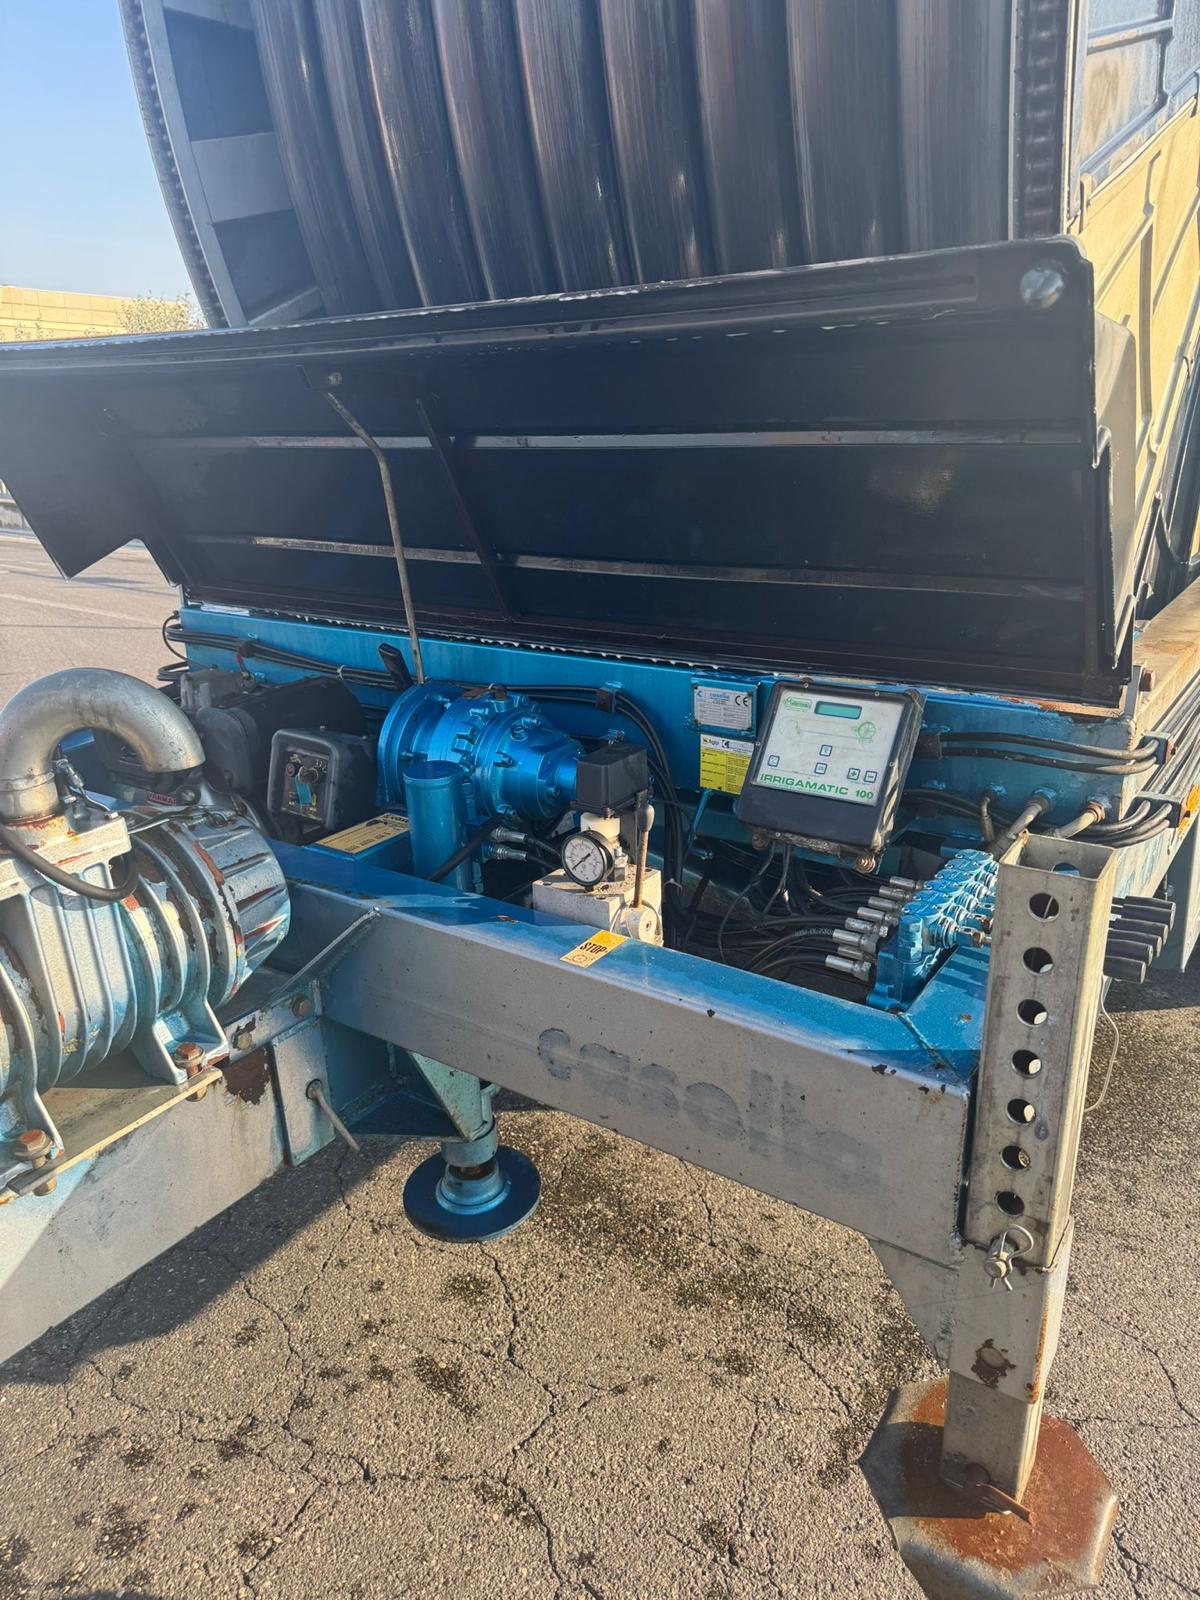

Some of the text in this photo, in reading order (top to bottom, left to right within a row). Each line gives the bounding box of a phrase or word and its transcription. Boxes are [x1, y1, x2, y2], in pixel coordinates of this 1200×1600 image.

[759, 773, 875, 800] IRRIGAMATIC 100
[579, 942, 608, 954] STOP
